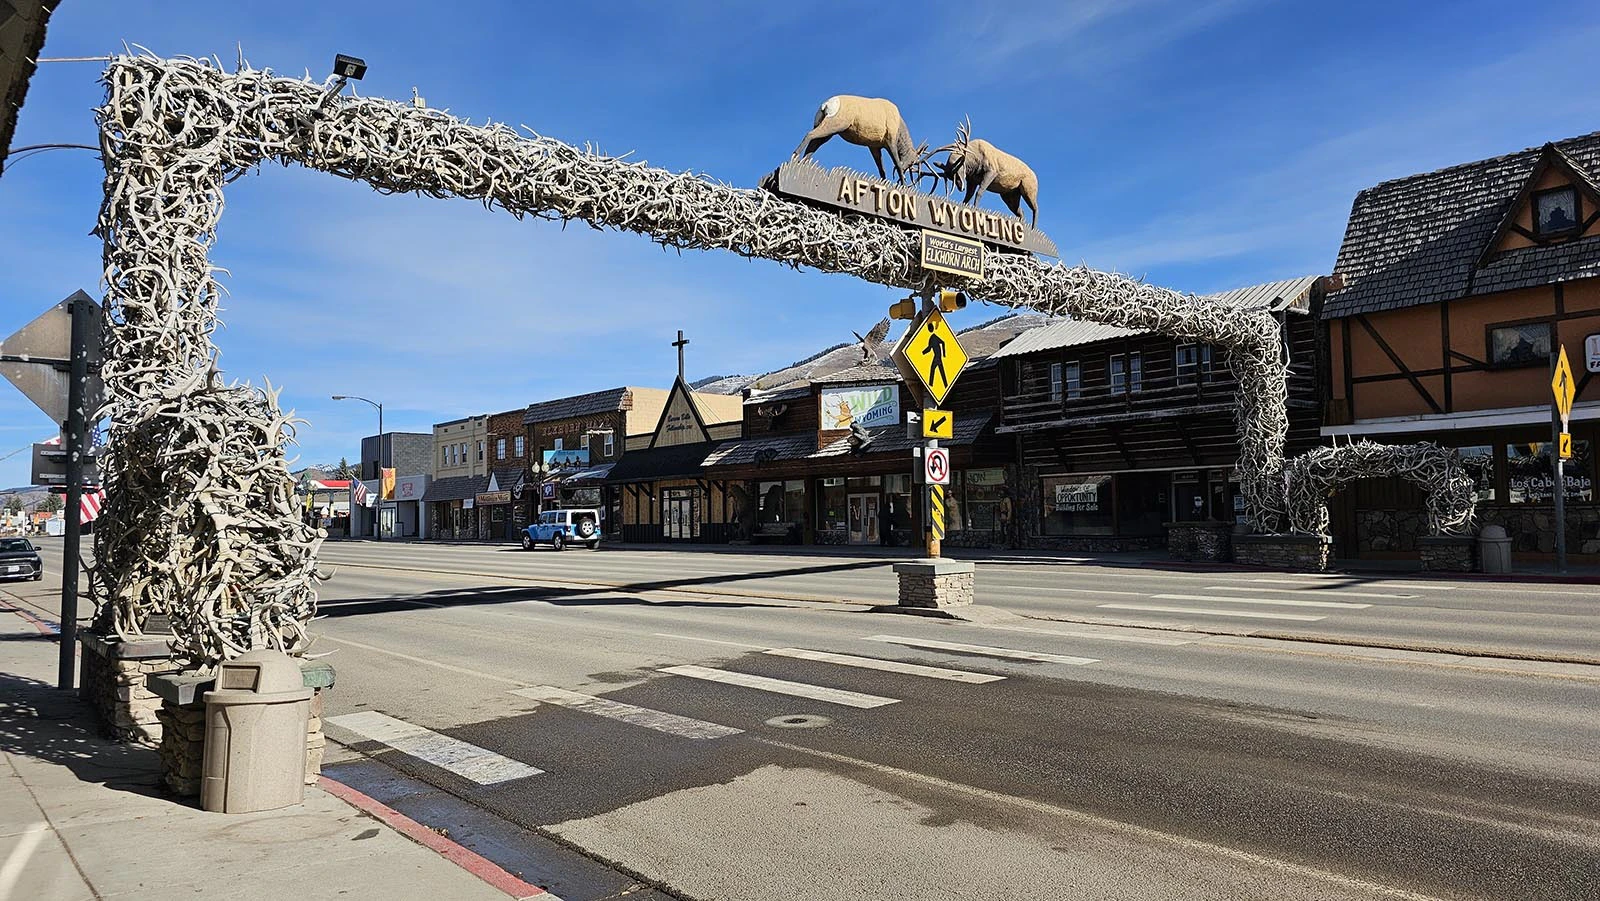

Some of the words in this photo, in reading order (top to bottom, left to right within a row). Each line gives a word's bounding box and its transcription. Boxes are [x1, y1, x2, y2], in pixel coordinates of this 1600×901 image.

[837, 176, 917, 221] AFTON
[928, 199, 1025, 244] WYOMING
[929, 237, 954, 250] World's
[954, 243, 978, 256] Largest
[926, 247, 960, 268] ELKHORN
[960, 255, 980, 272] ARCH
[849, 386, 893, 413] WILD
[854, 405, 893, 423] WYOMING
[1511, 478, 1529, 488] Los
[1567, 476, 1591, 489] Baja
